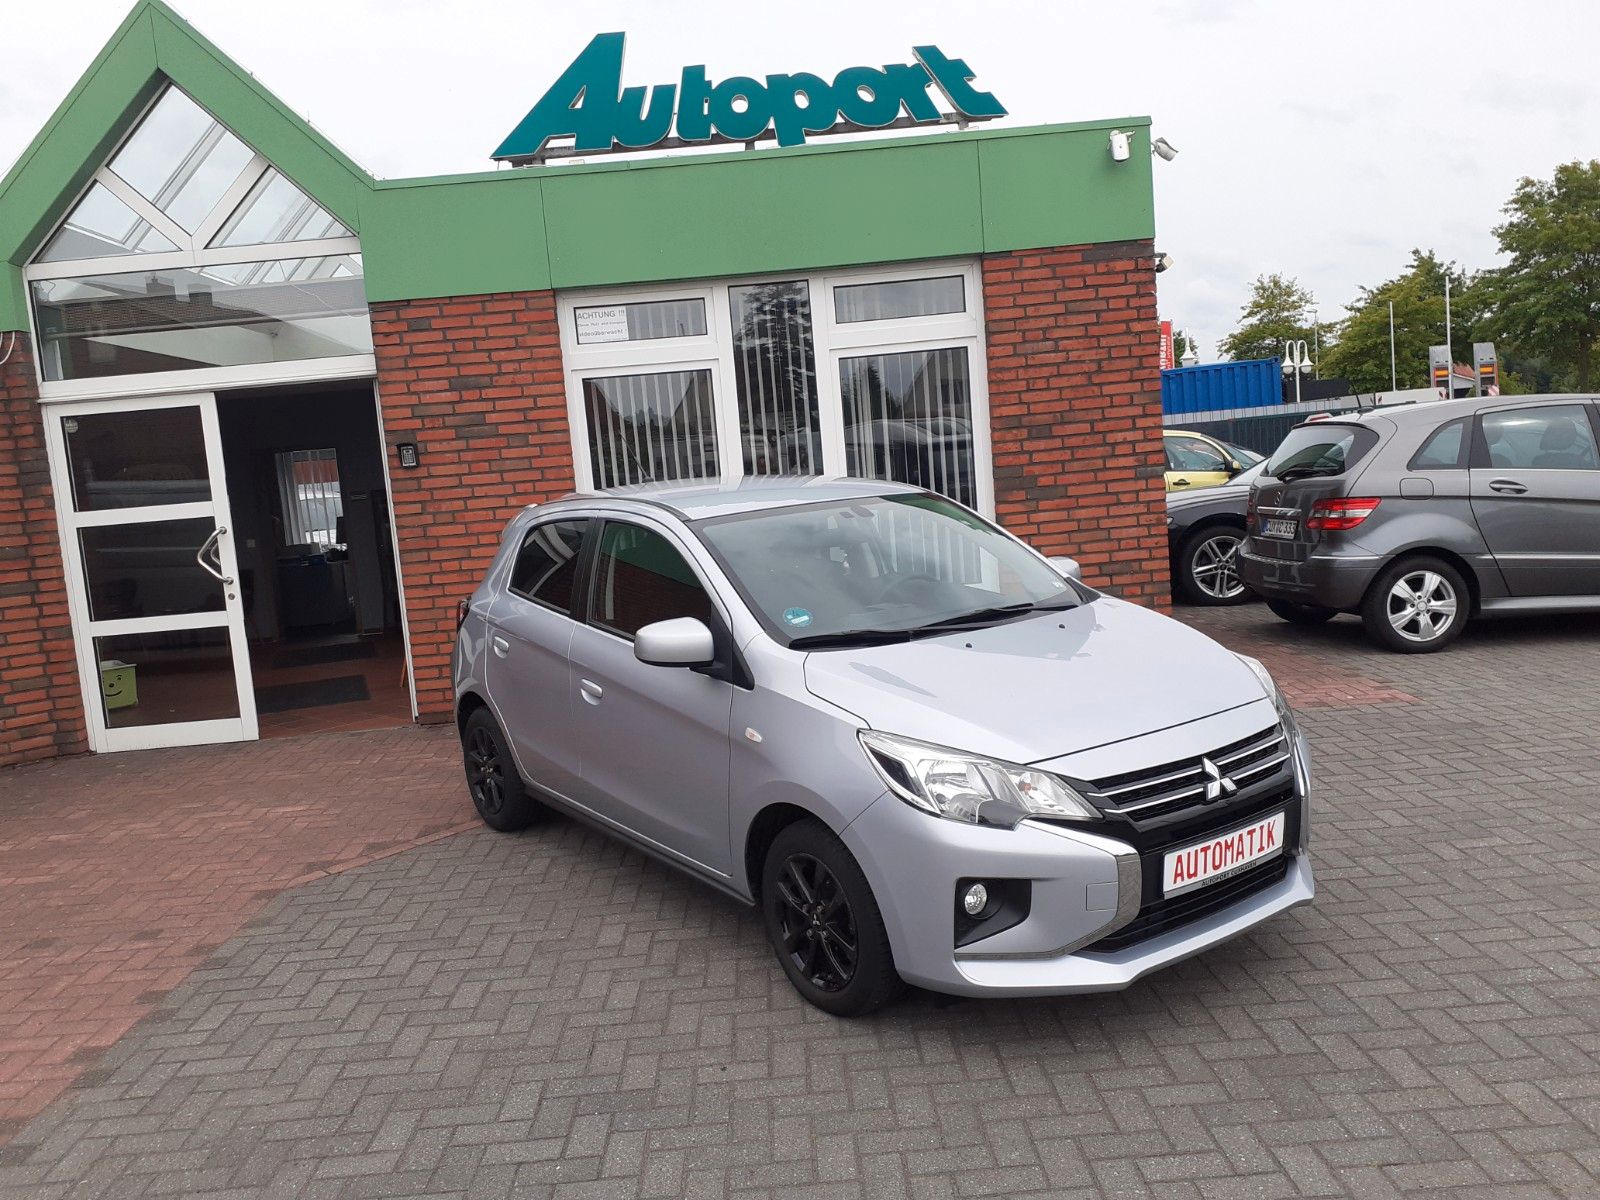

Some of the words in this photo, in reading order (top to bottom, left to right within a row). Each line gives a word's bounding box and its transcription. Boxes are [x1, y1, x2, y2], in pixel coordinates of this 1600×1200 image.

[488, 32, 1008, 160] Autoport
[577, 311, 616, 320] ACHTUNG
[1173, 818, 1277, 885] AUTOMATIK
[1201, 872, 1230, 887] AUTOPORT
